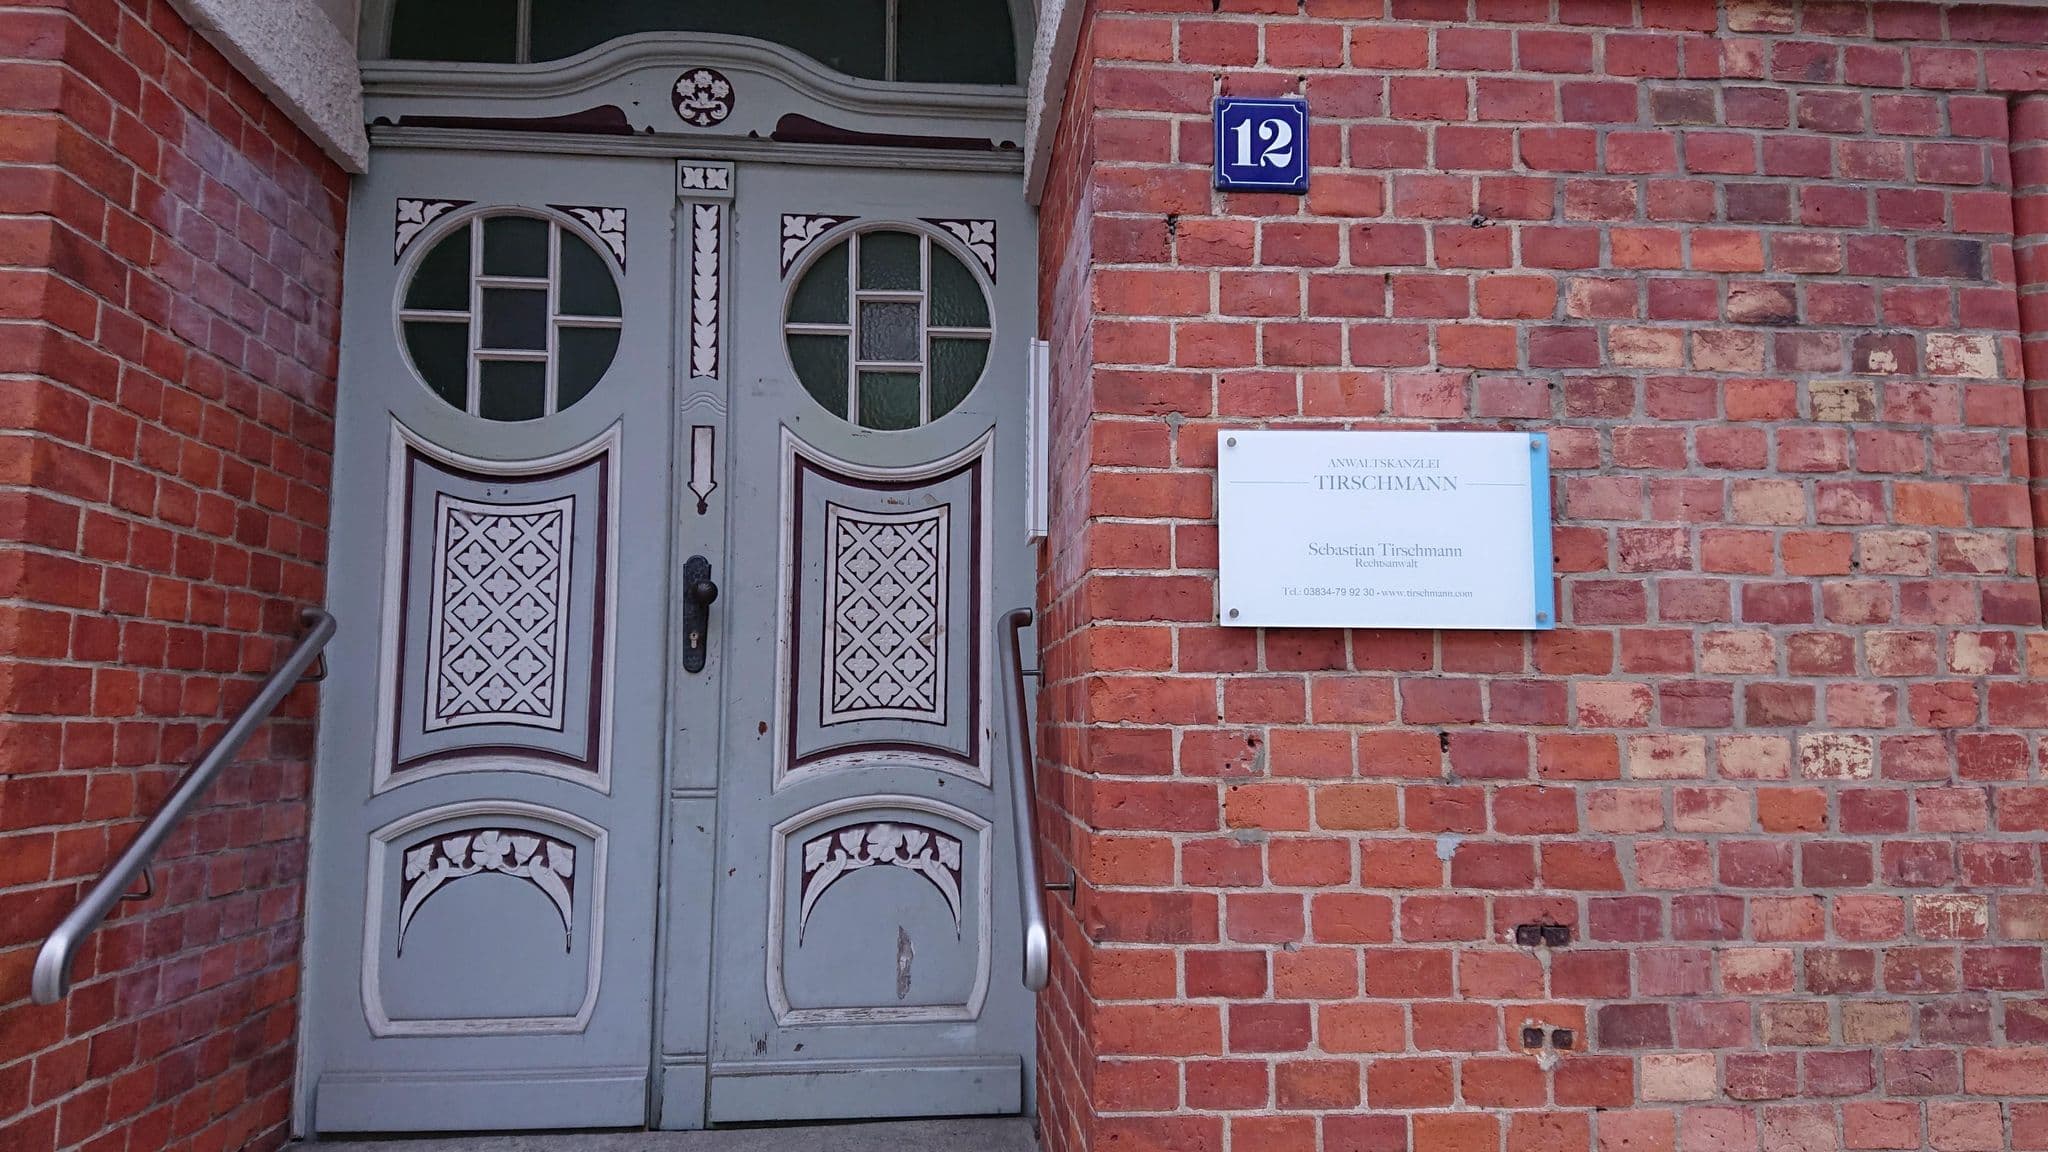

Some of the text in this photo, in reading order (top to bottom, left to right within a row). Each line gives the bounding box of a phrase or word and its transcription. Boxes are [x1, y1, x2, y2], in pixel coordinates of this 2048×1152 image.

[1230, 118, 1293, 168] 12
[1328, 458, 1440, 469] ANWALTSKANZLEI
[1314, 475, 1457, 491] TIRSCHMANN
[1308, 542, 1463, 558] Sebastian Tirschmann
[1355, 558, 1418, 569] Rechtsanwalt
[1303, 587, 1347, 597] 03834-79
[1349, 588, 1360, 597] 92
[1363, 588, 1375, 597] 30
[1381, 588, 1473, 598] www.tirschmann.com
